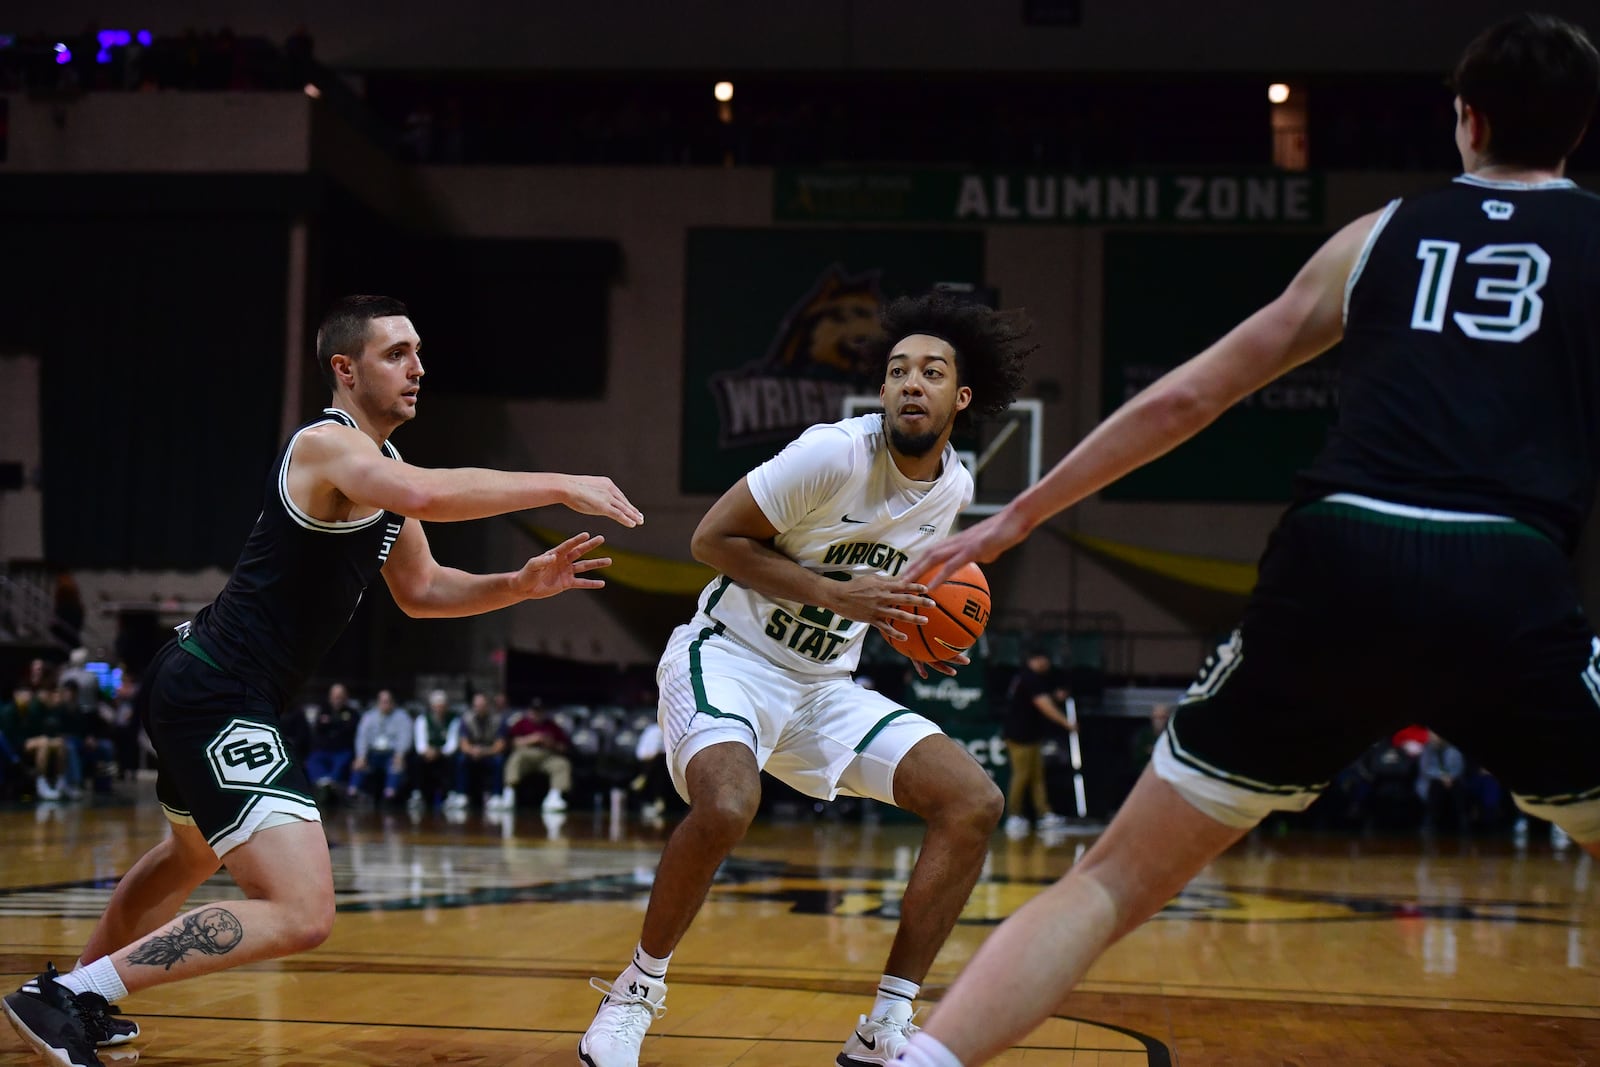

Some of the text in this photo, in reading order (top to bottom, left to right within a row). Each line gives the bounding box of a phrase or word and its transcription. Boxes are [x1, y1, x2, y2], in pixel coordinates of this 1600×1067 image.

[955, 175, 1160, 220] ALUMNI
[1173, 176, 1312, 221] ZONE
[1409, 238, 1552, 344] 13
[765, 608, 850, 661] STAT
[221, 738, 274, 770] GB
